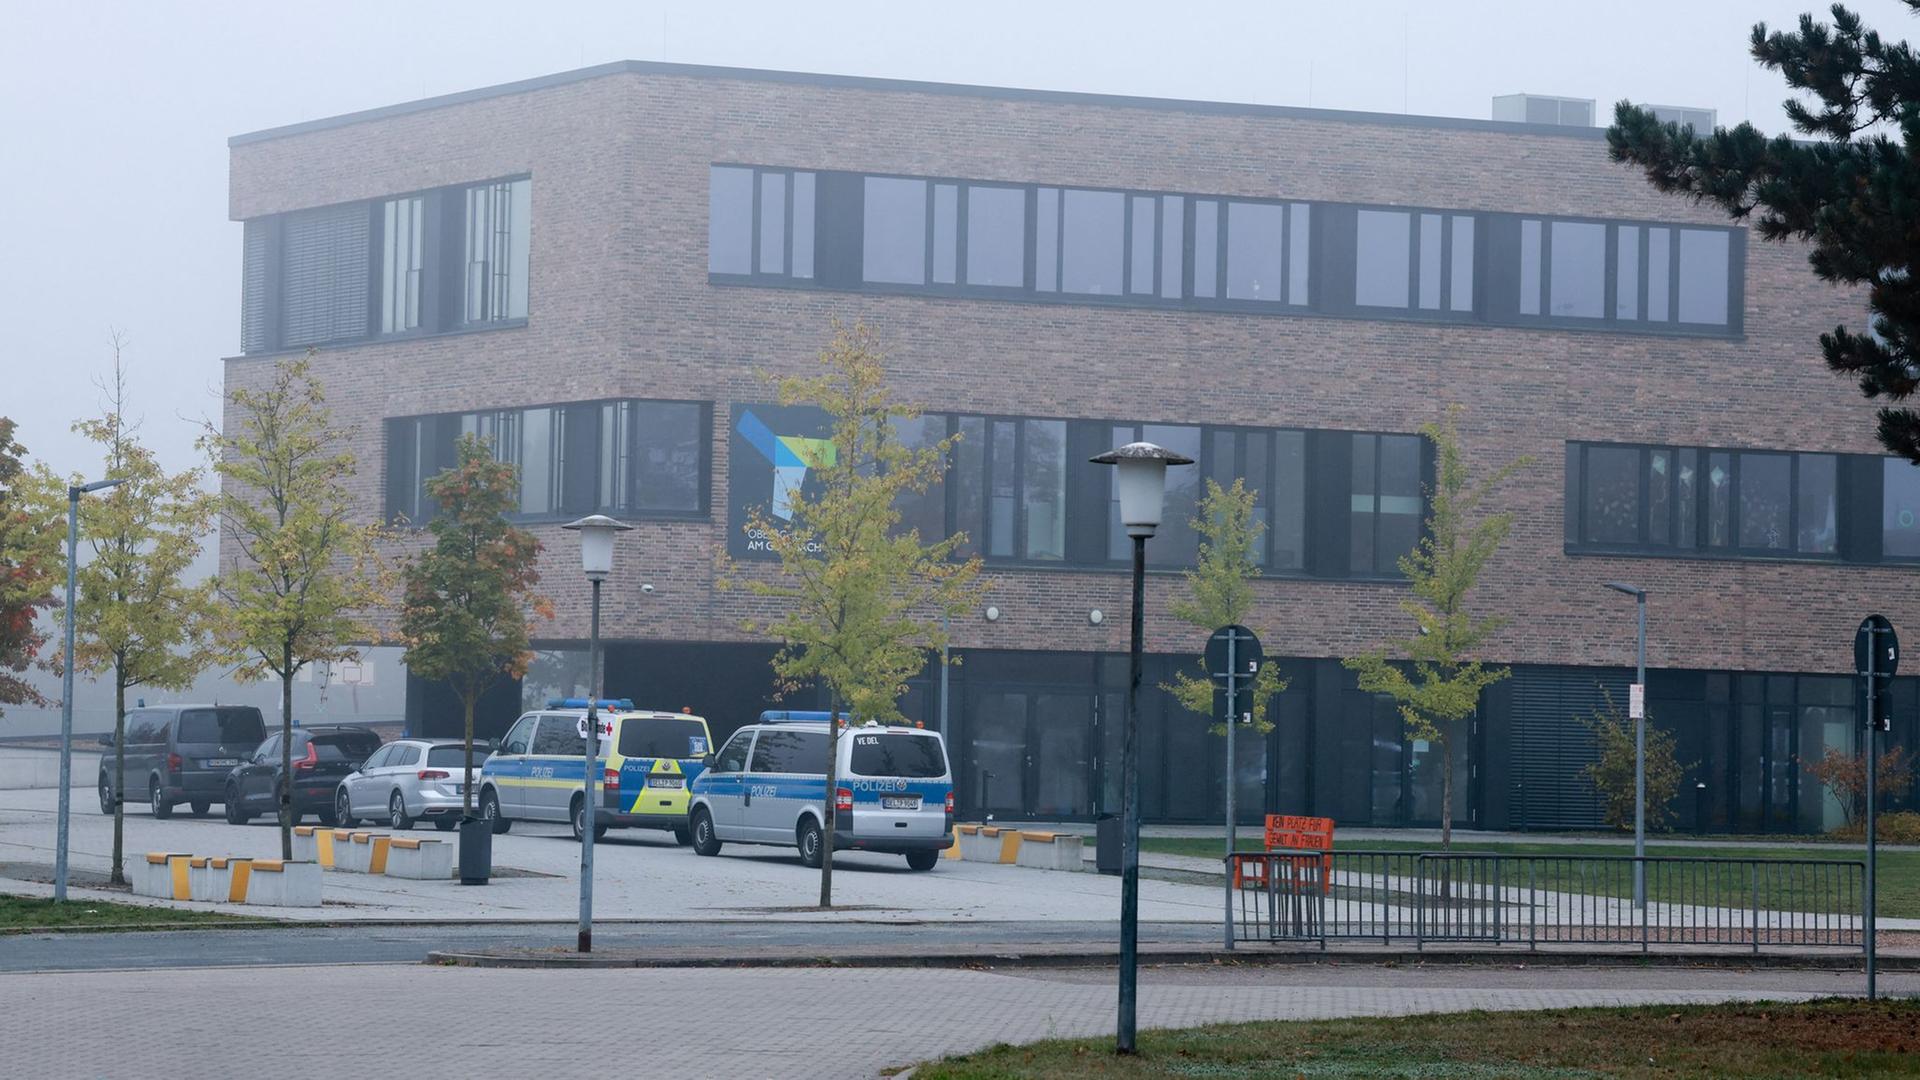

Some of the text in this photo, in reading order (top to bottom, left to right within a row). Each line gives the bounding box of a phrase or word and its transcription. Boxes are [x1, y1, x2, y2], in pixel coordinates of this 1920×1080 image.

[748, 541, 763, 551] AM
[857, 736, 879, 745] VE DEL
[531, 766, 554, 777] POLIZEI
[751, 785, 777, 798] POLIZEI
[853, 781, 895, 792] POLIZEI
